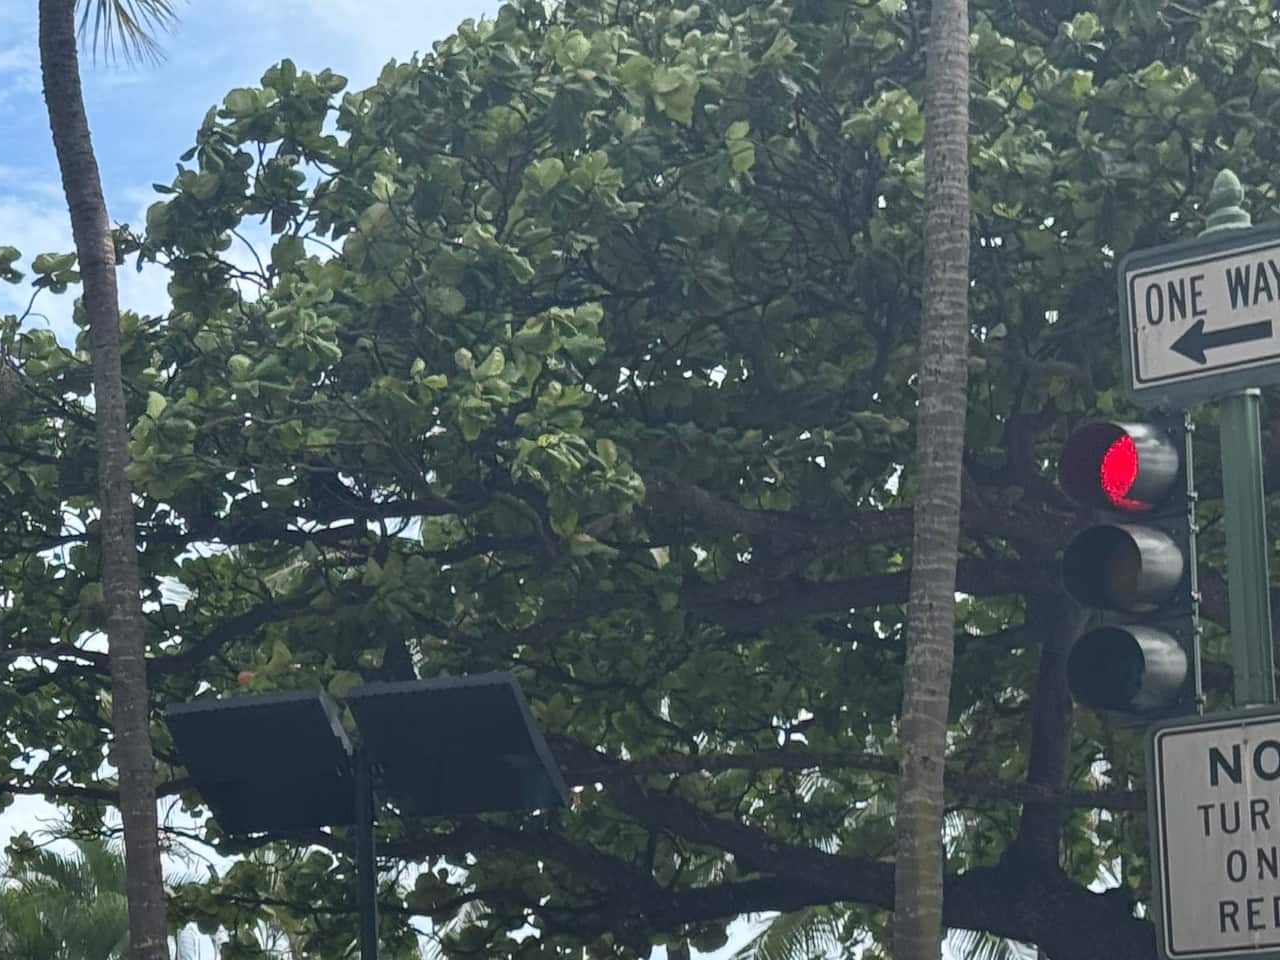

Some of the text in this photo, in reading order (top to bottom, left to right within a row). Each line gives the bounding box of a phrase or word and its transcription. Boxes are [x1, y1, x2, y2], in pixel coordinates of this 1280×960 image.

[1145, 258, 1280, 326] ONE WAY
[1209, 739, 1280, 787] NO
[1197, 797, 1280, 837] TUR
[1226, 846, 1280, 883] ON
